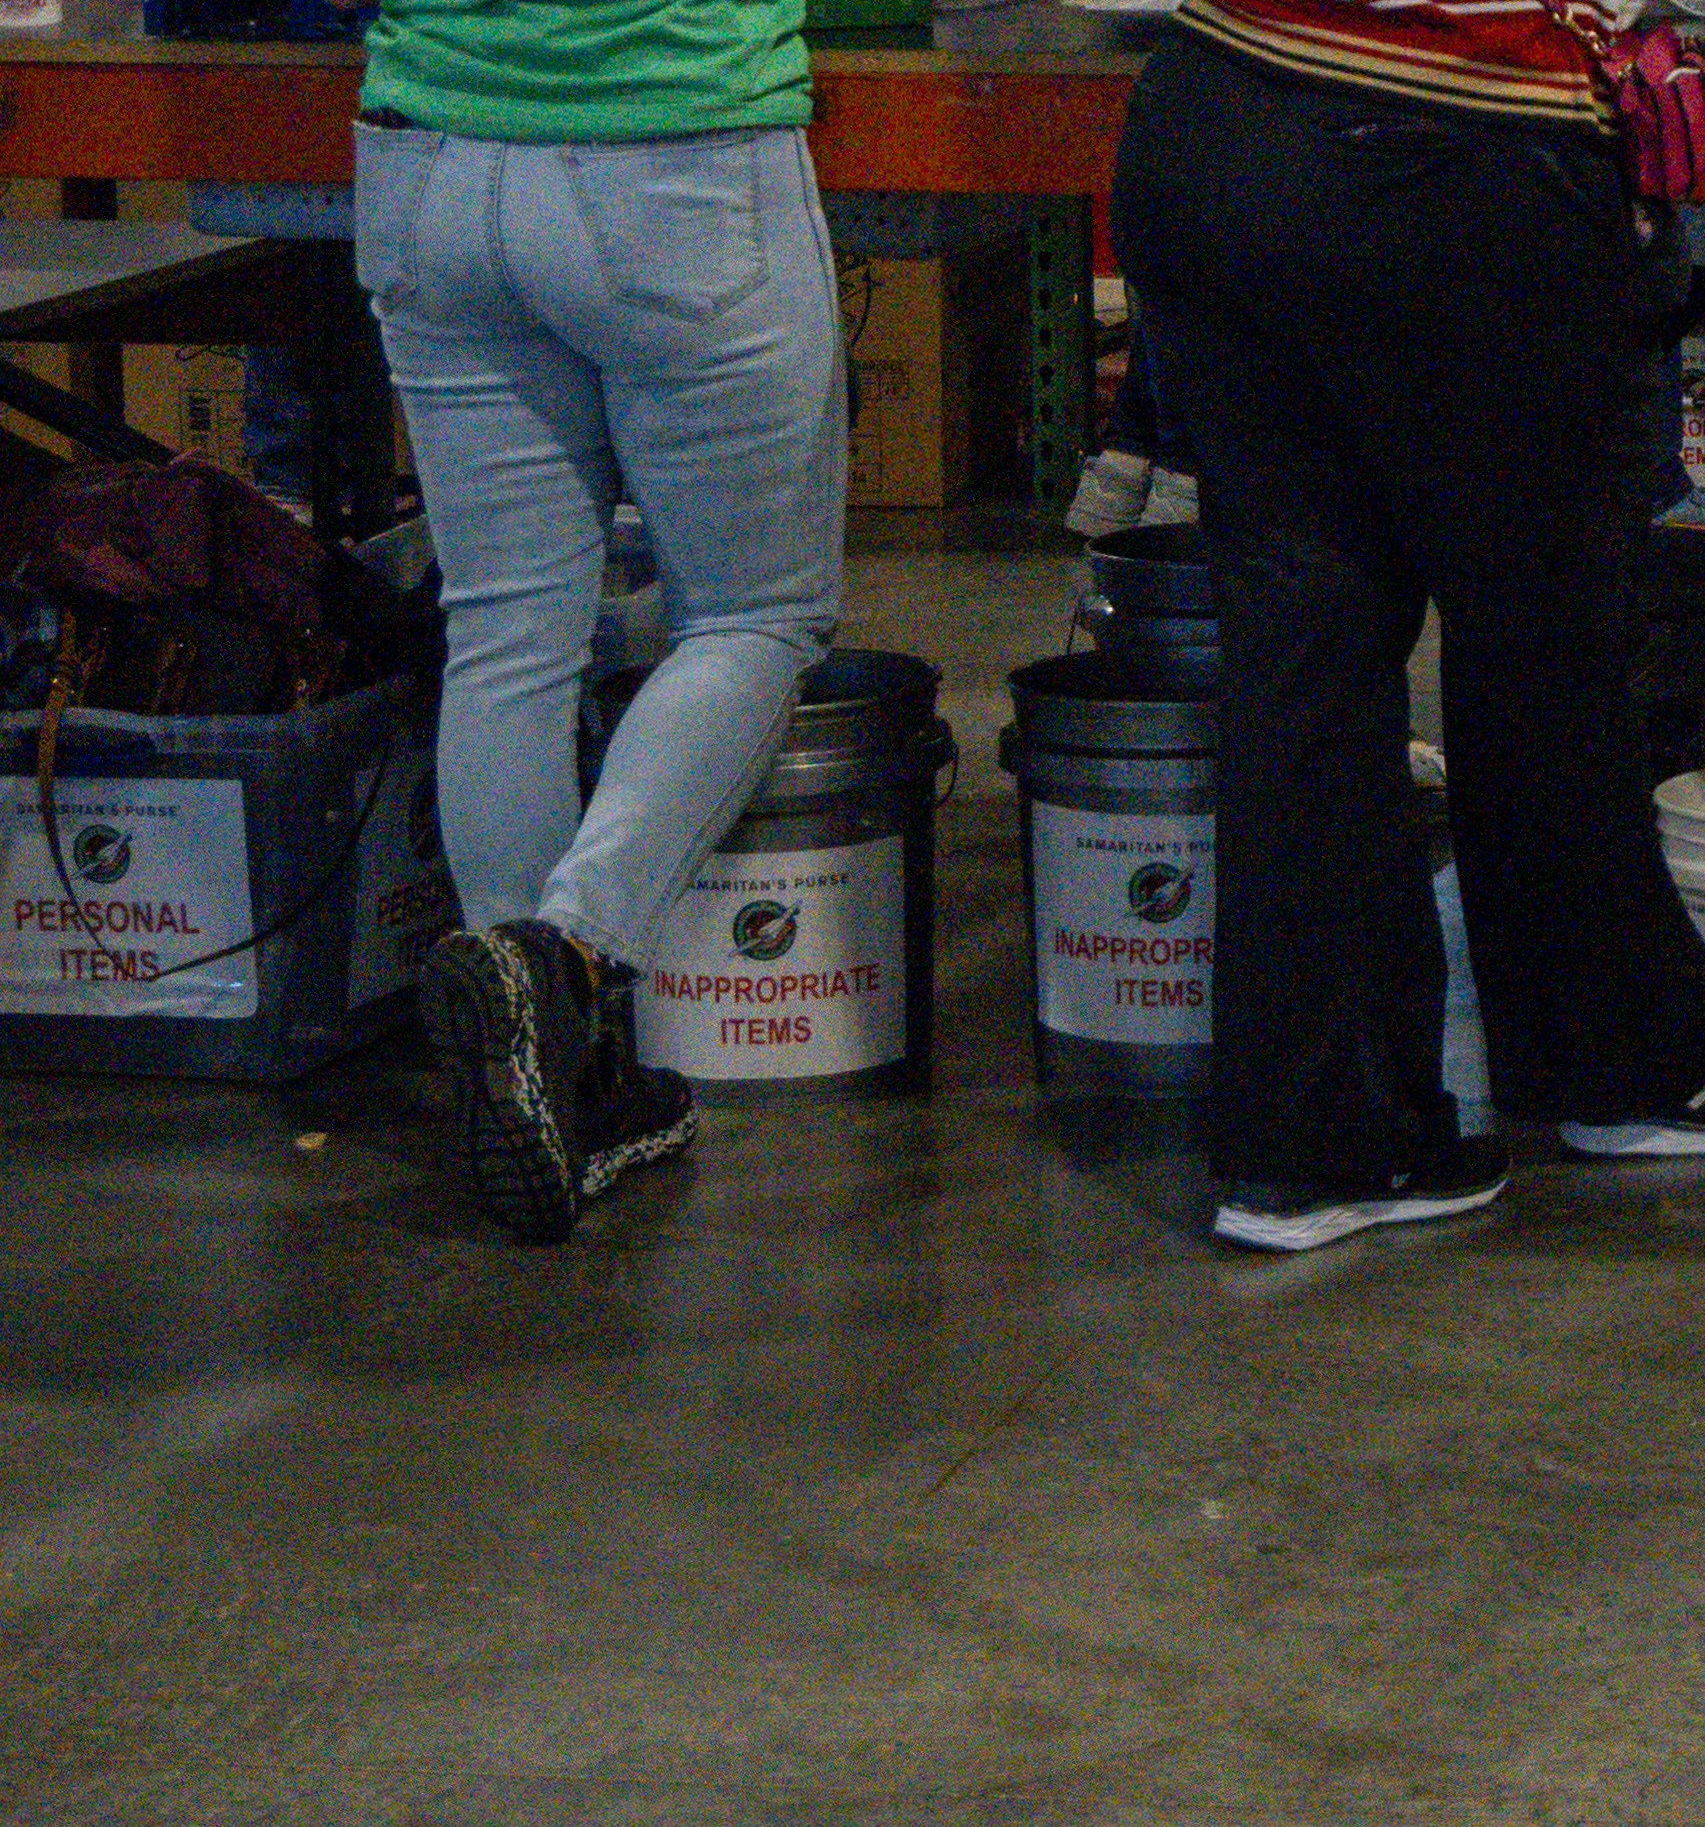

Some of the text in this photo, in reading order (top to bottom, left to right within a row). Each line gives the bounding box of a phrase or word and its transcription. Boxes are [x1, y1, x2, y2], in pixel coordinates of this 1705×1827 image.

[124, 805, 180, 817] PURSE
[1076, 836, 1182, 855] SAMARITAN'S
[686, 874, 850, 893] AMARITAN'S PURSE
[14, 899, 200, 935] PERSONAL
[60, 948, 162, 983] ITEMS
[654, 962, 882, 1004] INAPPROPRIATE
[1115, 978, 1205, 1008] ITEMS
[719, 1015, 812, 1046] ITEMS
